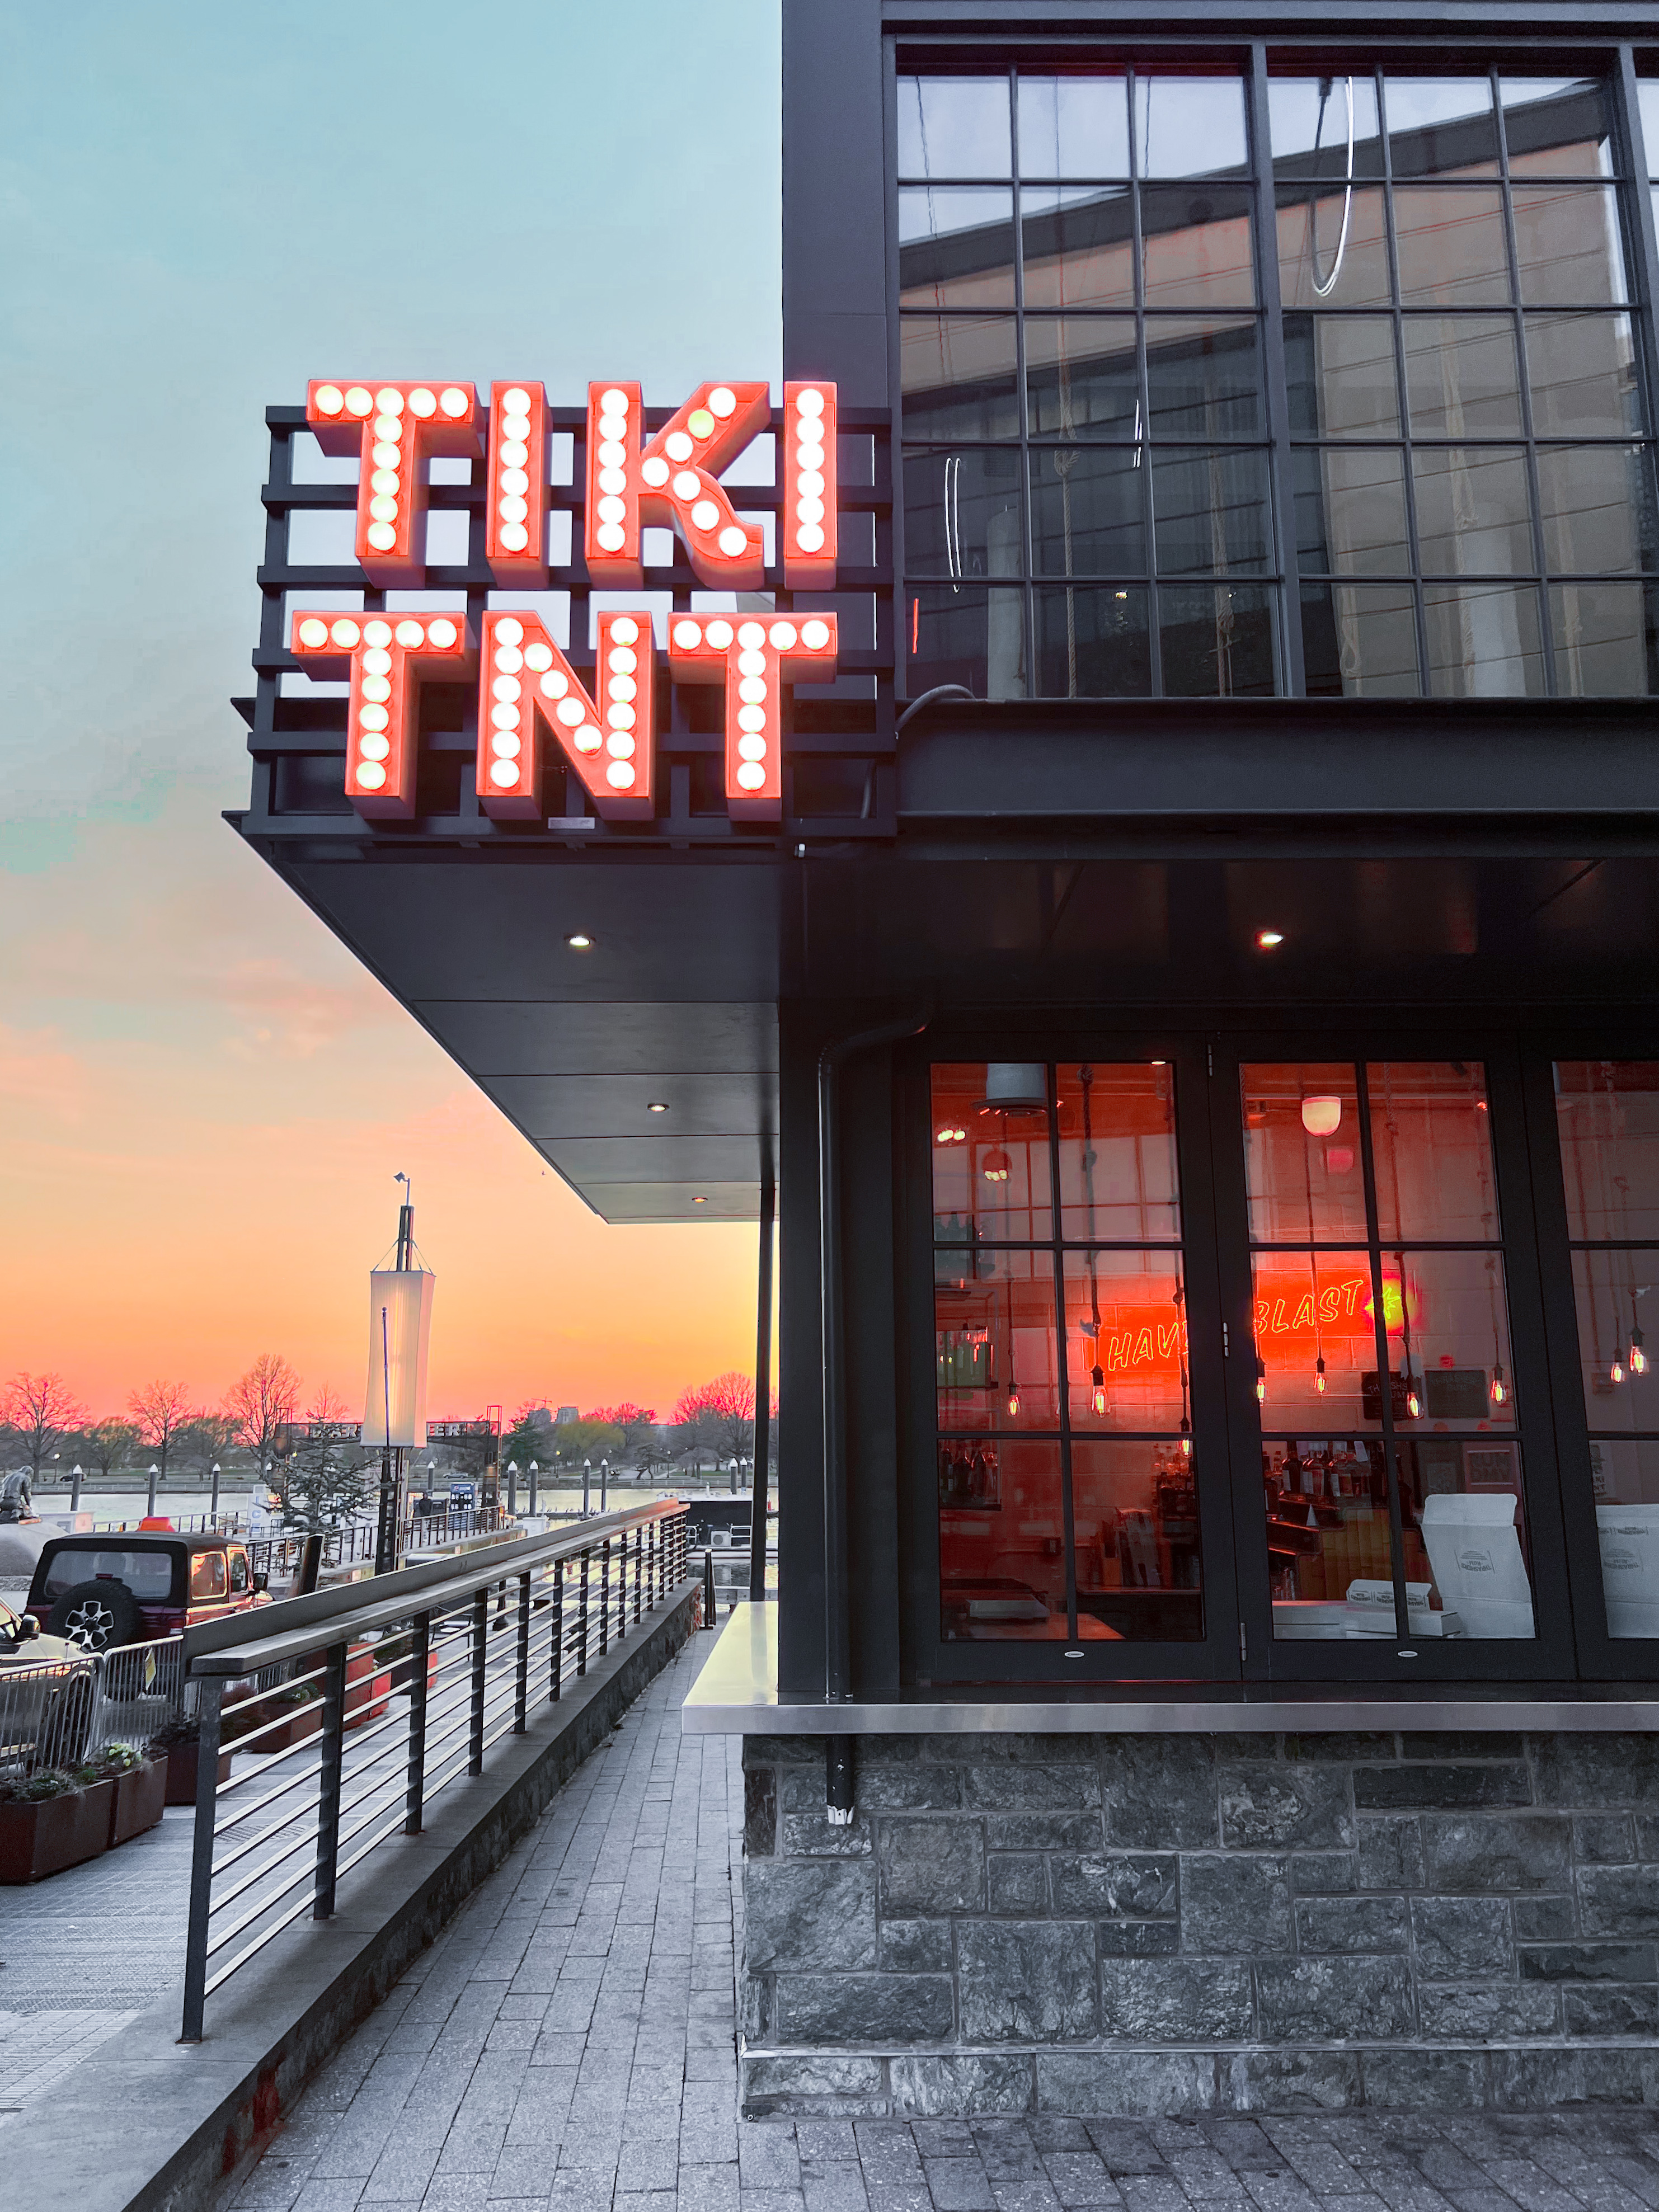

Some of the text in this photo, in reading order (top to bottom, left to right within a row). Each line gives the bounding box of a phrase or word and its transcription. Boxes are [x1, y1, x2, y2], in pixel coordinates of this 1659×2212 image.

[306, 379, 838, 571] TIKI
[291, 610, 838, 806] TNT
[1257, 1279, 1364, 1335] BLAST
[426, 1422, 460, 1437] IER
